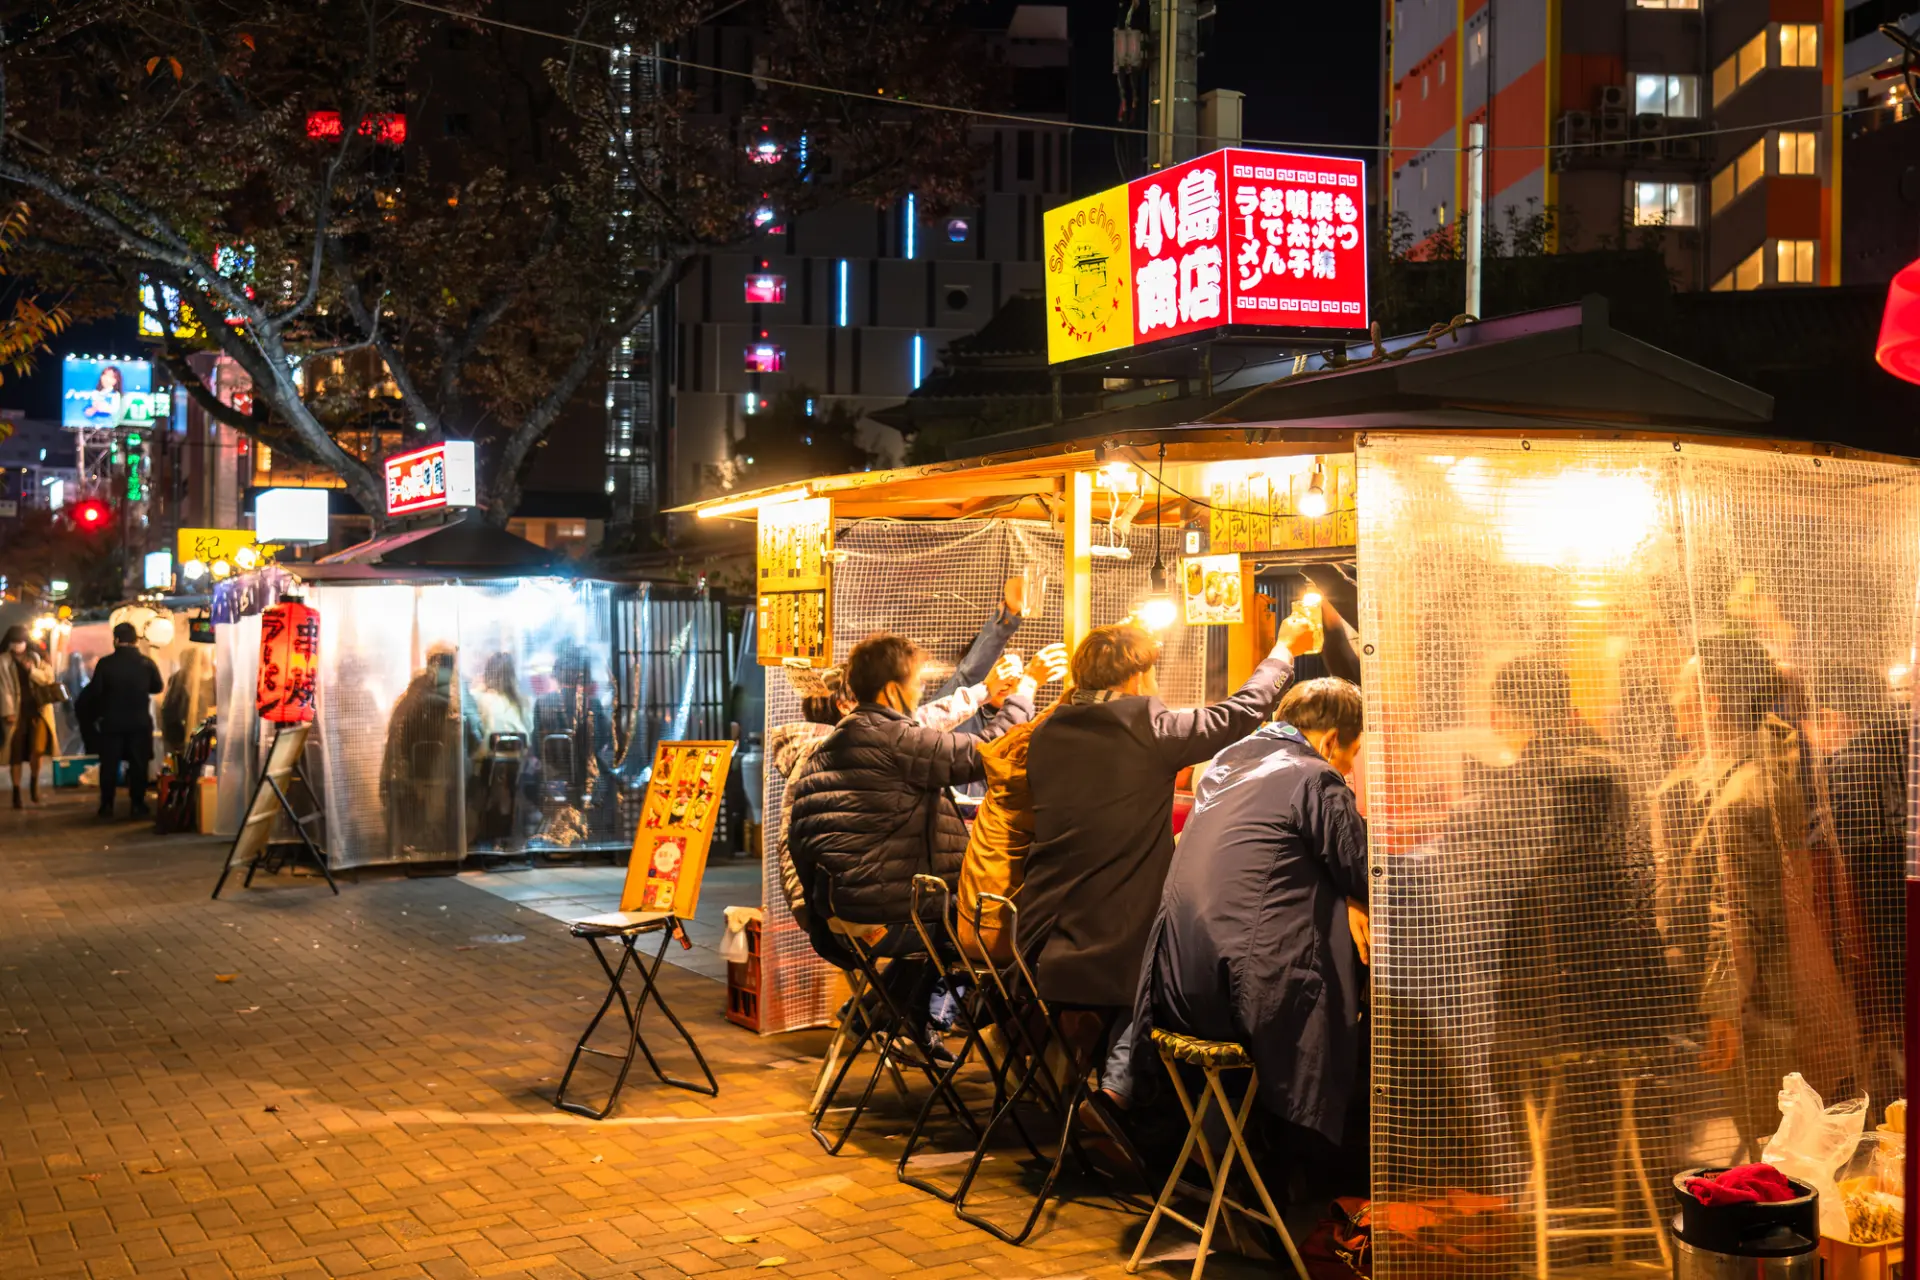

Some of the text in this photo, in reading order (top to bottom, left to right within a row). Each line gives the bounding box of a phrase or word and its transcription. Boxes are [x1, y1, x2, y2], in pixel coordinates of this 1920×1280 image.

[1089, 203, 1122, 254] chan
[1135, 169, 1220, 257] 小島
[1235, 186, 1262, 291] ラーメン
[1260, 187, 1286, 275] おでん
[1285, 189, 1311, 278] 明太子
[1310, 191, 1336, 279] 炭火焼
[1334, 193, 1359, 250] もつ
[1136, 245, 1222, 334] 商店
